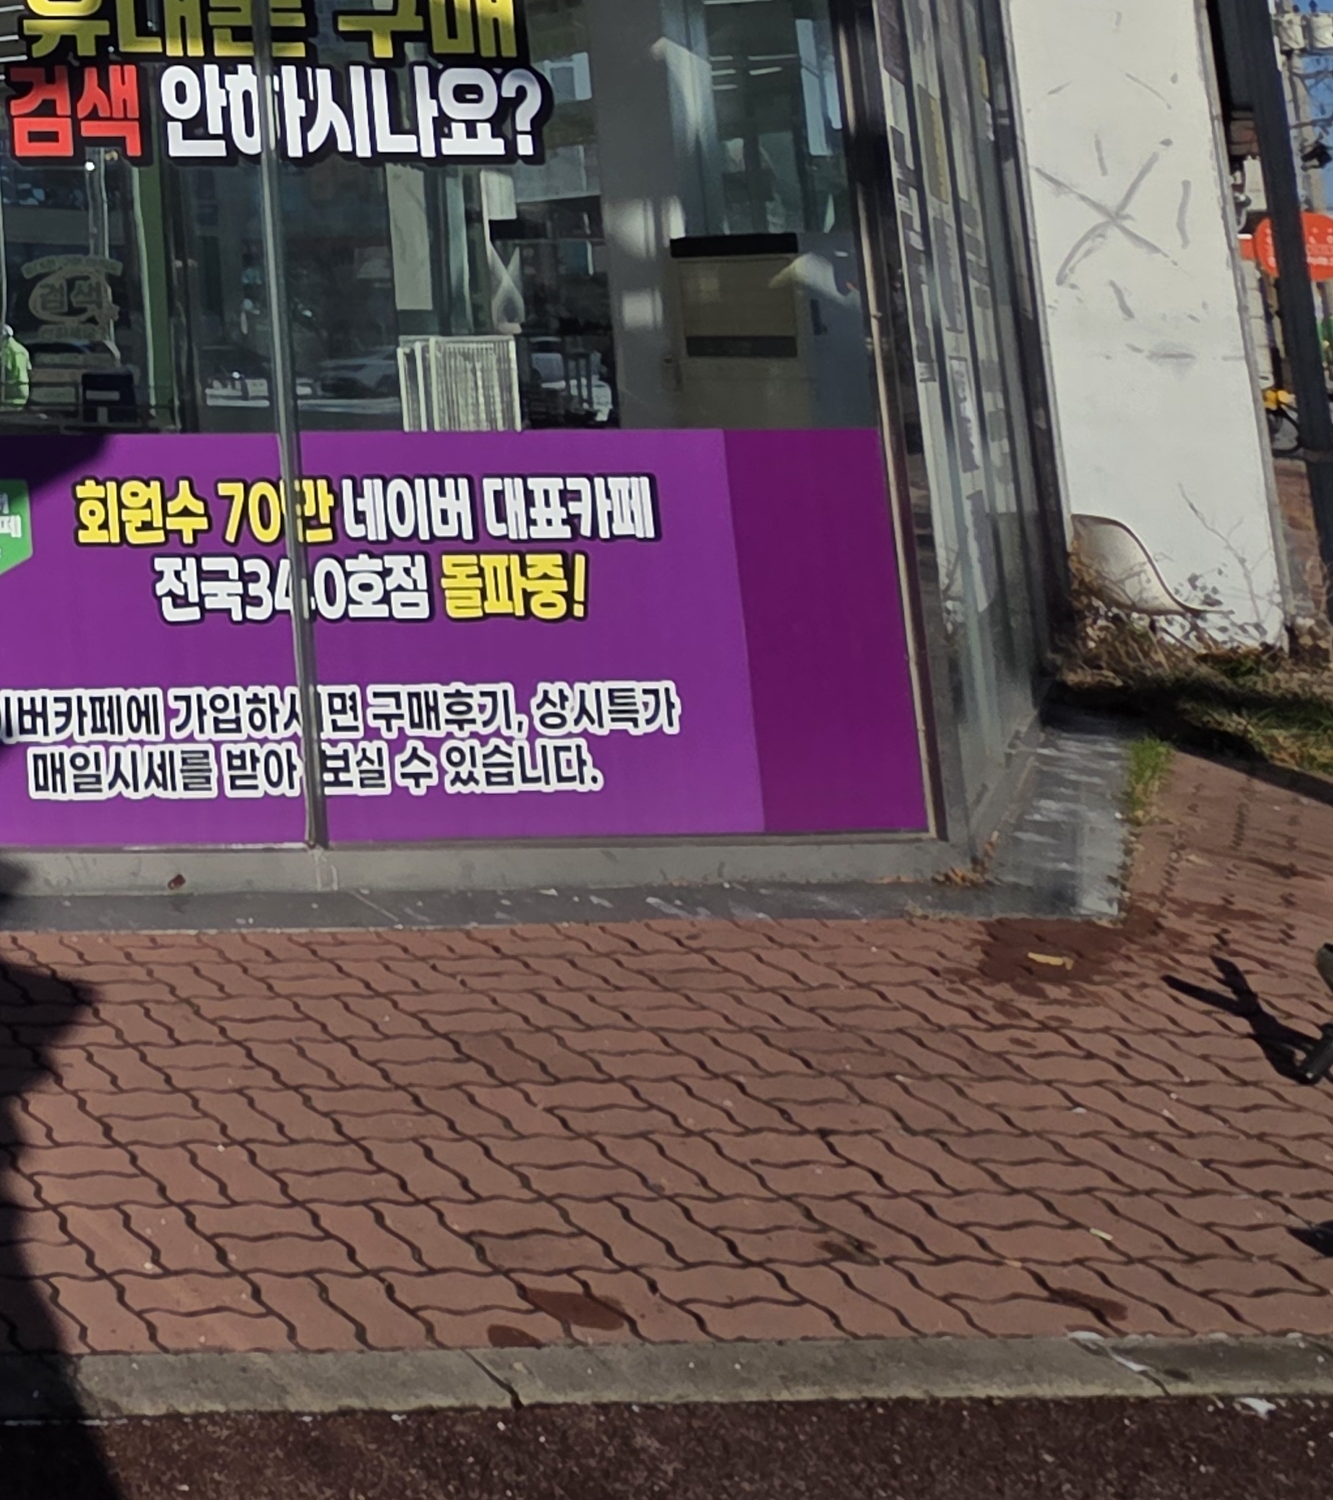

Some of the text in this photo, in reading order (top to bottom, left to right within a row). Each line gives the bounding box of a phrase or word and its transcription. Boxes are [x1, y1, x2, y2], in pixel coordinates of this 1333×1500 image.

[9, 64, 543, 159] 검색 안하시나요?
[75, 476, 655, 544] 회원수 70만 네이버 대표카페
[441, 553, 586, 618] 돌파중!
[372, 687, 525, 733] 구매후기,
[535, 686, 676, 729] 상시특가
[33, 749, 212, 794] 매일시세를
[399, 746, 433, 789] 수
[445, 744, 598, 788] 있습니다.
